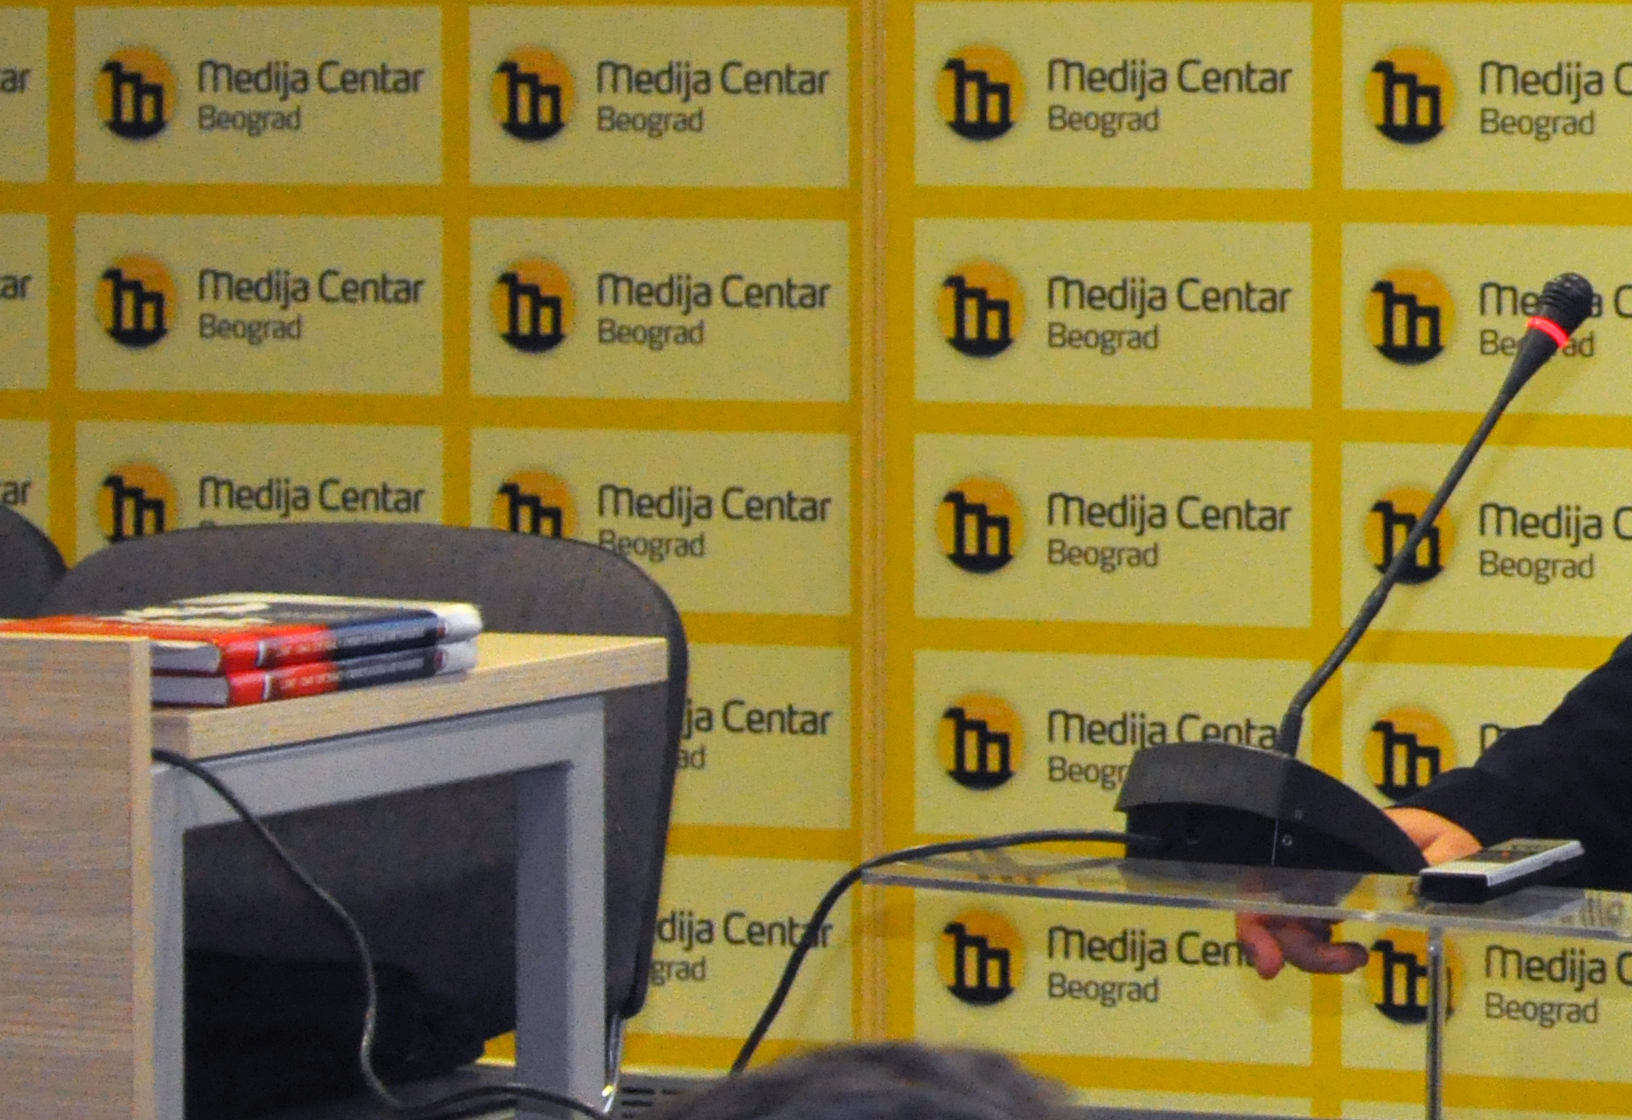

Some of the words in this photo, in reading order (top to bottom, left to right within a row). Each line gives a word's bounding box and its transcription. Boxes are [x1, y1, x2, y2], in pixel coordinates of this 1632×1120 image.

[197, 59, 310, 102] Medija
[317, 59, 425, 95] Centar
[596, 60, 712, 104] Medija
[719, 60, 830, 96] Centar
[1047, 58, 1169, 102] Medija
[1177, 58, 1293, 94] Centar
[1480, 60, 1606, 105] Medija
[198, 104, 301, 137] Beograd
[597, 105, 704, 138] Beograd
[1047, 104, 1160, 138] Beograd
[1480, 107, 1596, 142] Beograd
[198, 268, 310, 311] Medija
[317, 268, 425, 305] Centar
[597, 272, 713, 316] Medija
[720, 273, 831, 310] Centar
[1047, 275, 1169, 320] Medija
[1177, 276, 1293, 314] Centar
[199, 313, 302, 346] Beograd
[598, 318, 704, 351] Beograd
[1047, 322, 1160, 355] Beograd
[198, 475, 311, 519] Medija
[318, 477, 425, 514] Centar
[597, 483, 713, 528] Medija
[721, 486, 832, 523] Centar
[1047, 491, 1169, 537] Medija
[1177, 494, 1293, 533] Centar
[1480, 502, 1606, 549] Medija
[1047, 538, 1160, 573] Beograd
[1480, 550, 1596, 585] Beograd
[721, 698, 832, 736] Centar
[1047, 924, 1169, 973] Medija
[1485, 944, 1608, 993] Medija
[1047, 972, 1160, 1008] Beograd
[1485, 992, 1599, 1029] Beograd
